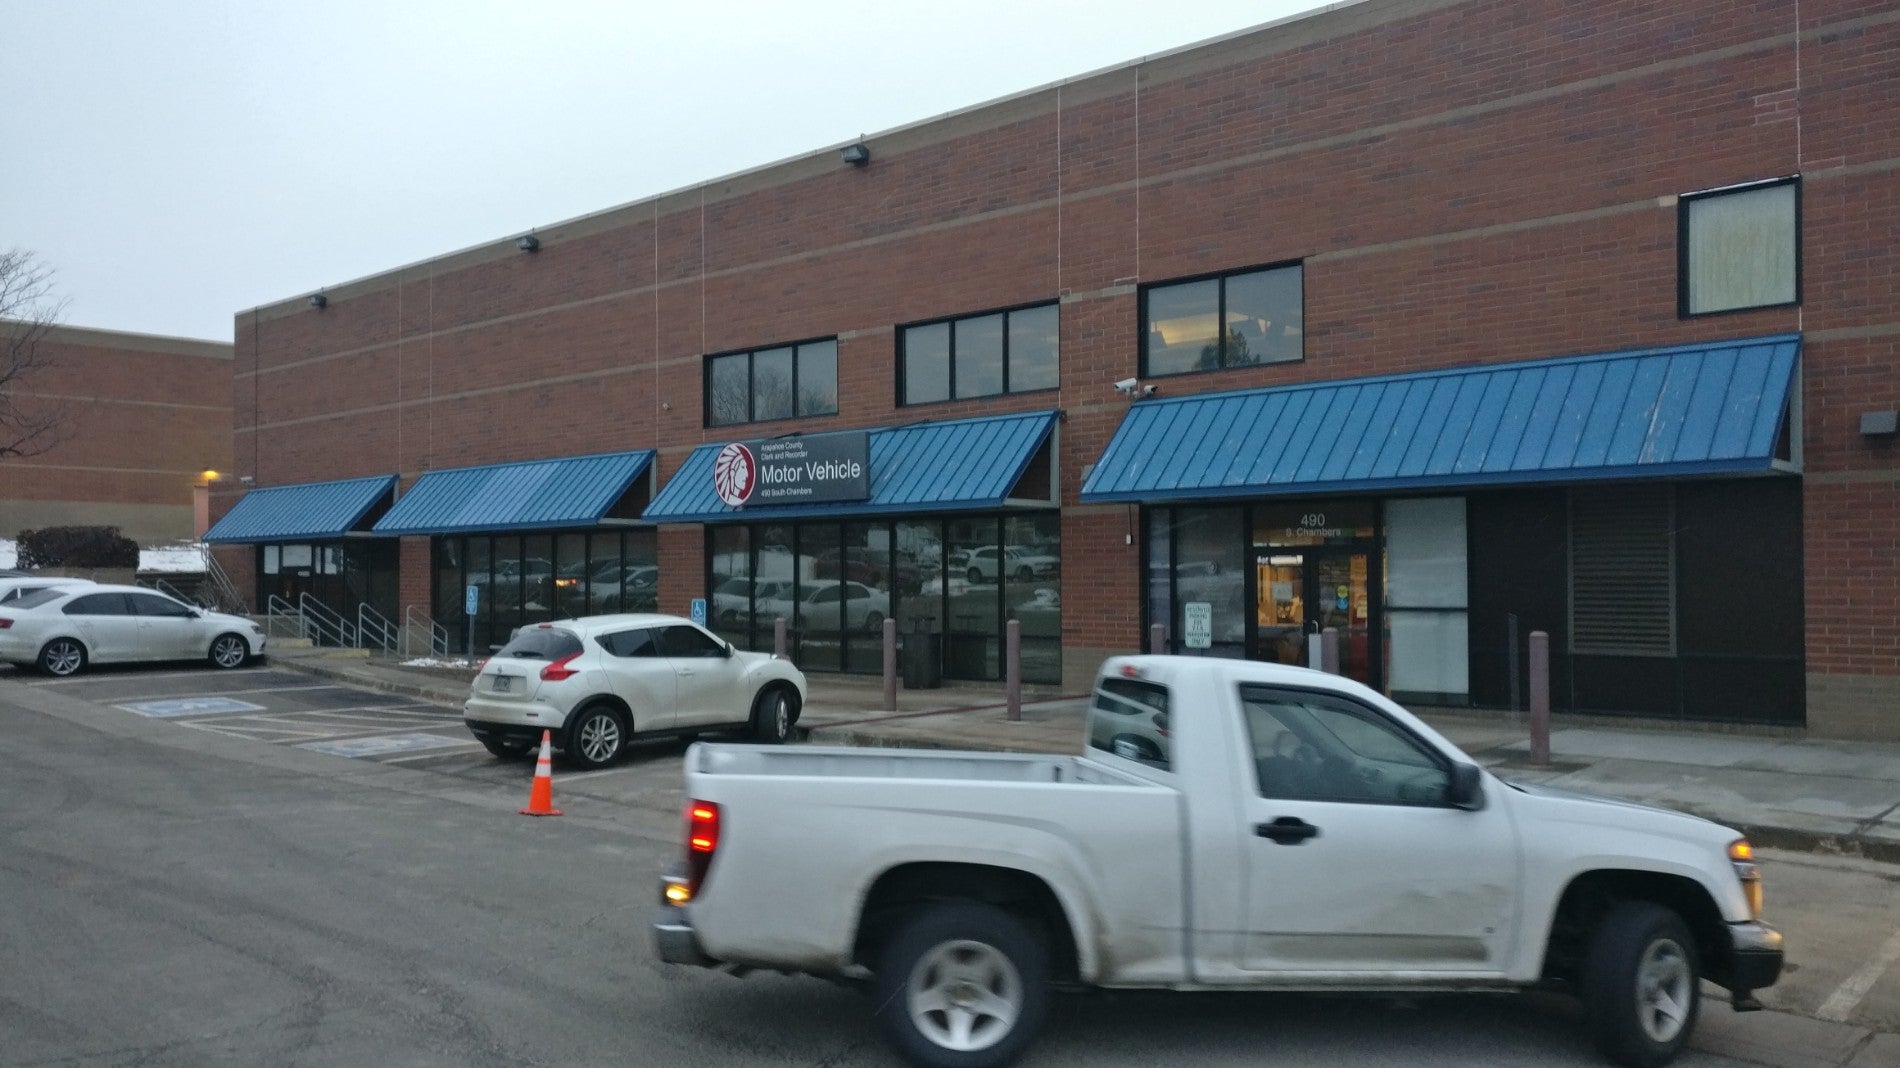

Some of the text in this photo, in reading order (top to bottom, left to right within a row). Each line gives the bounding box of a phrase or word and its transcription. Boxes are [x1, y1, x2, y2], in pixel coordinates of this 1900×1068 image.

[785, 441, 804, 450] County
[761, 450, 808, 461] Clerk and Recorder
[761, 459, 861, 484] Motor Vehicle
[1301, 513, 1326, 527] 490
[1296, 527, 1342, 537] Chambers
